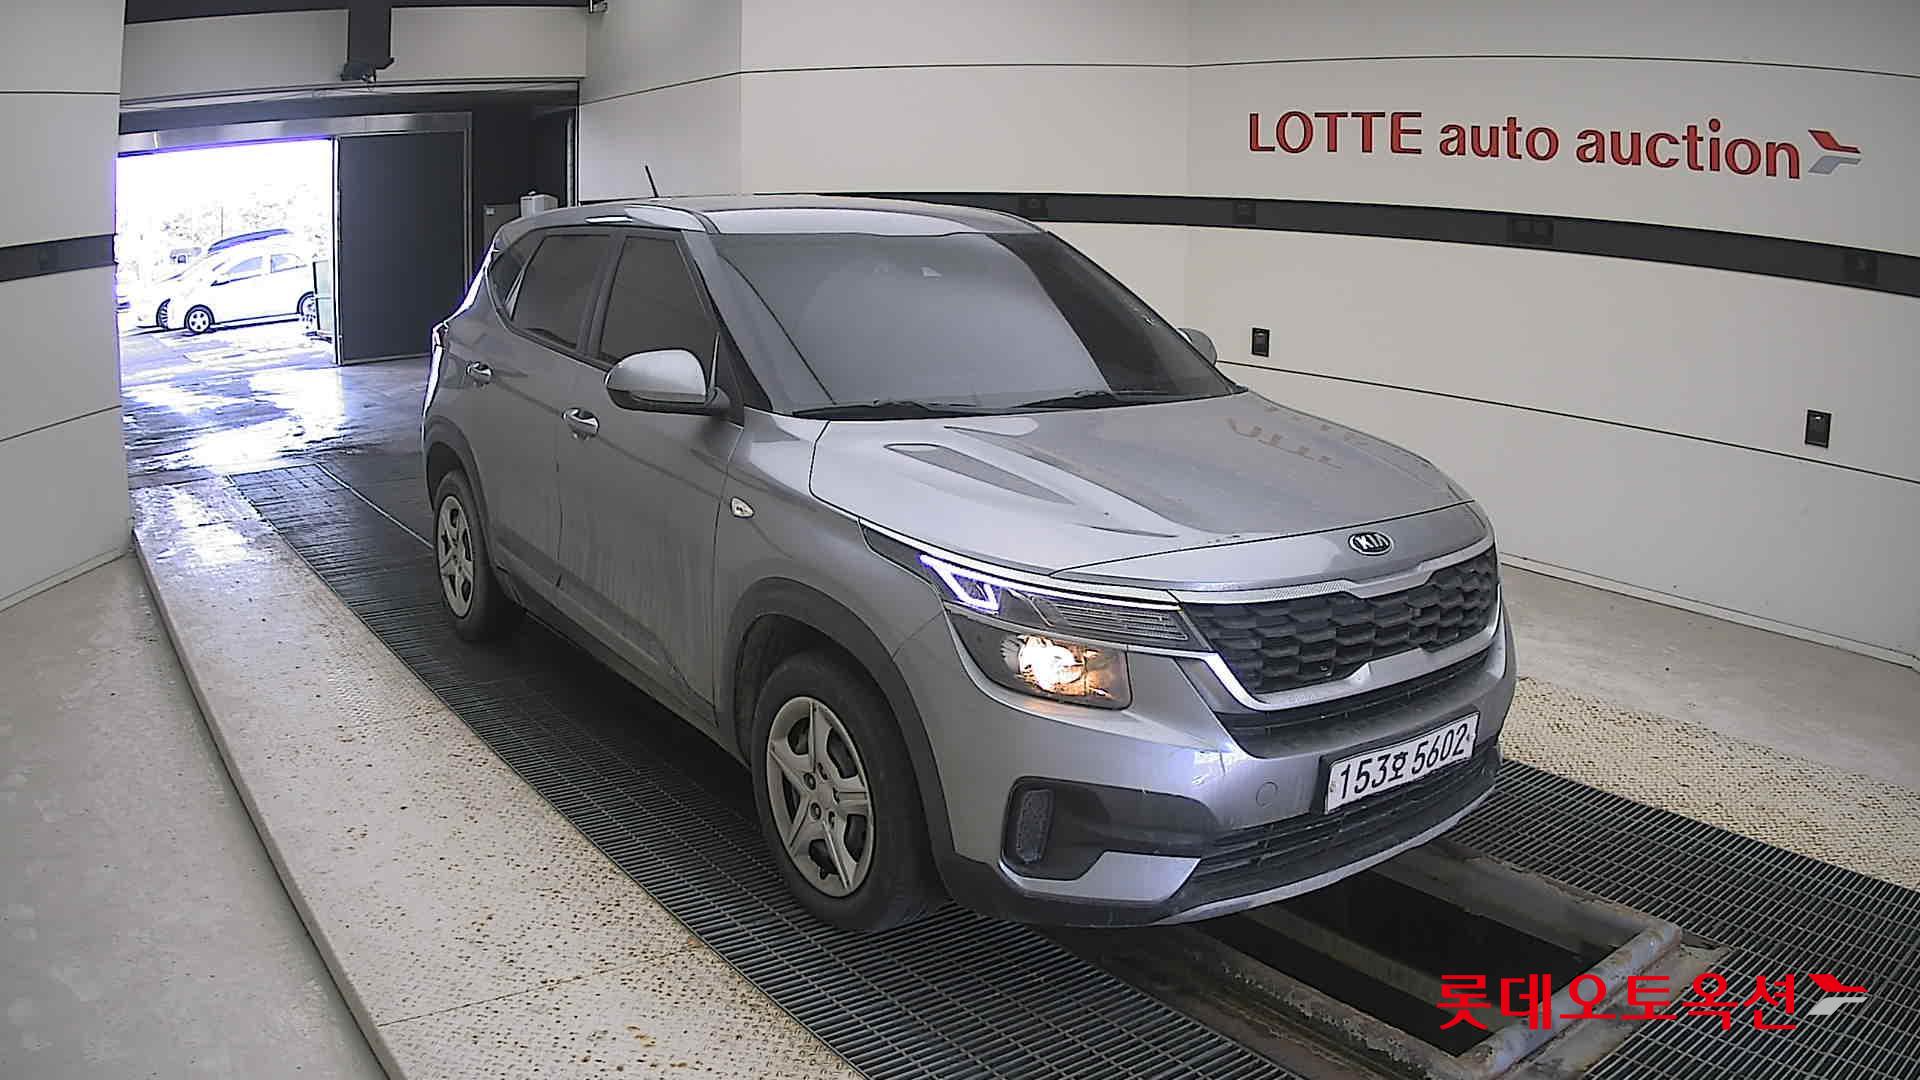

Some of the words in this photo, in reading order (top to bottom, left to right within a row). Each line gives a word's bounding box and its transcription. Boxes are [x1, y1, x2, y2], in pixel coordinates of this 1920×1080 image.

[1248, 111, 1423, 155] LOTTE
[1439, 116, 1560, 161] auto
[1575, 118, 1801, 180] auction
[1354, 534, 1390, 550] KIA
[1411, 723, 1468, 775] 5602
